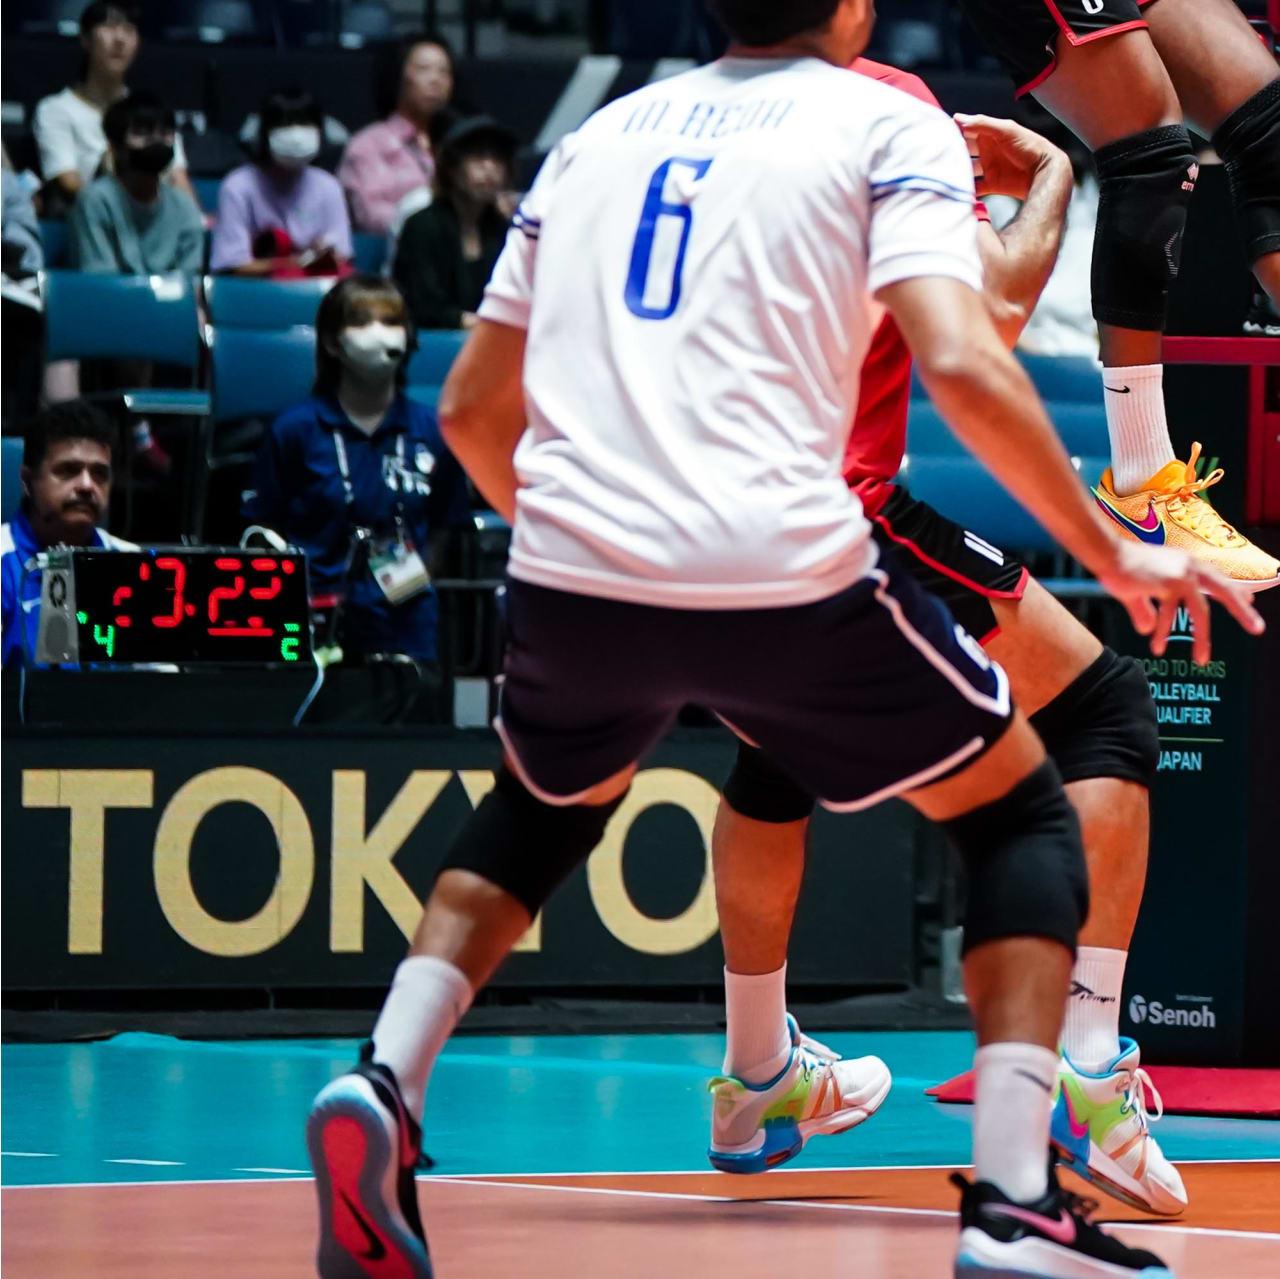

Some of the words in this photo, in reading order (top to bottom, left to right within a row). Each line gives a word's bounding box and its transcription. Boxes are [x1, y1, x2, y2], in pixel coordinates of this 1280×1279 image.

[623, 155, 715, 321] 6
[1172, 660, 1189, 677] TO
[1148, 682, 1221, 702] OLLEYBALL
[1156, 705, 1213, 725] UALIFIER
[1149, 1001, 1216, 1029] Senoh
